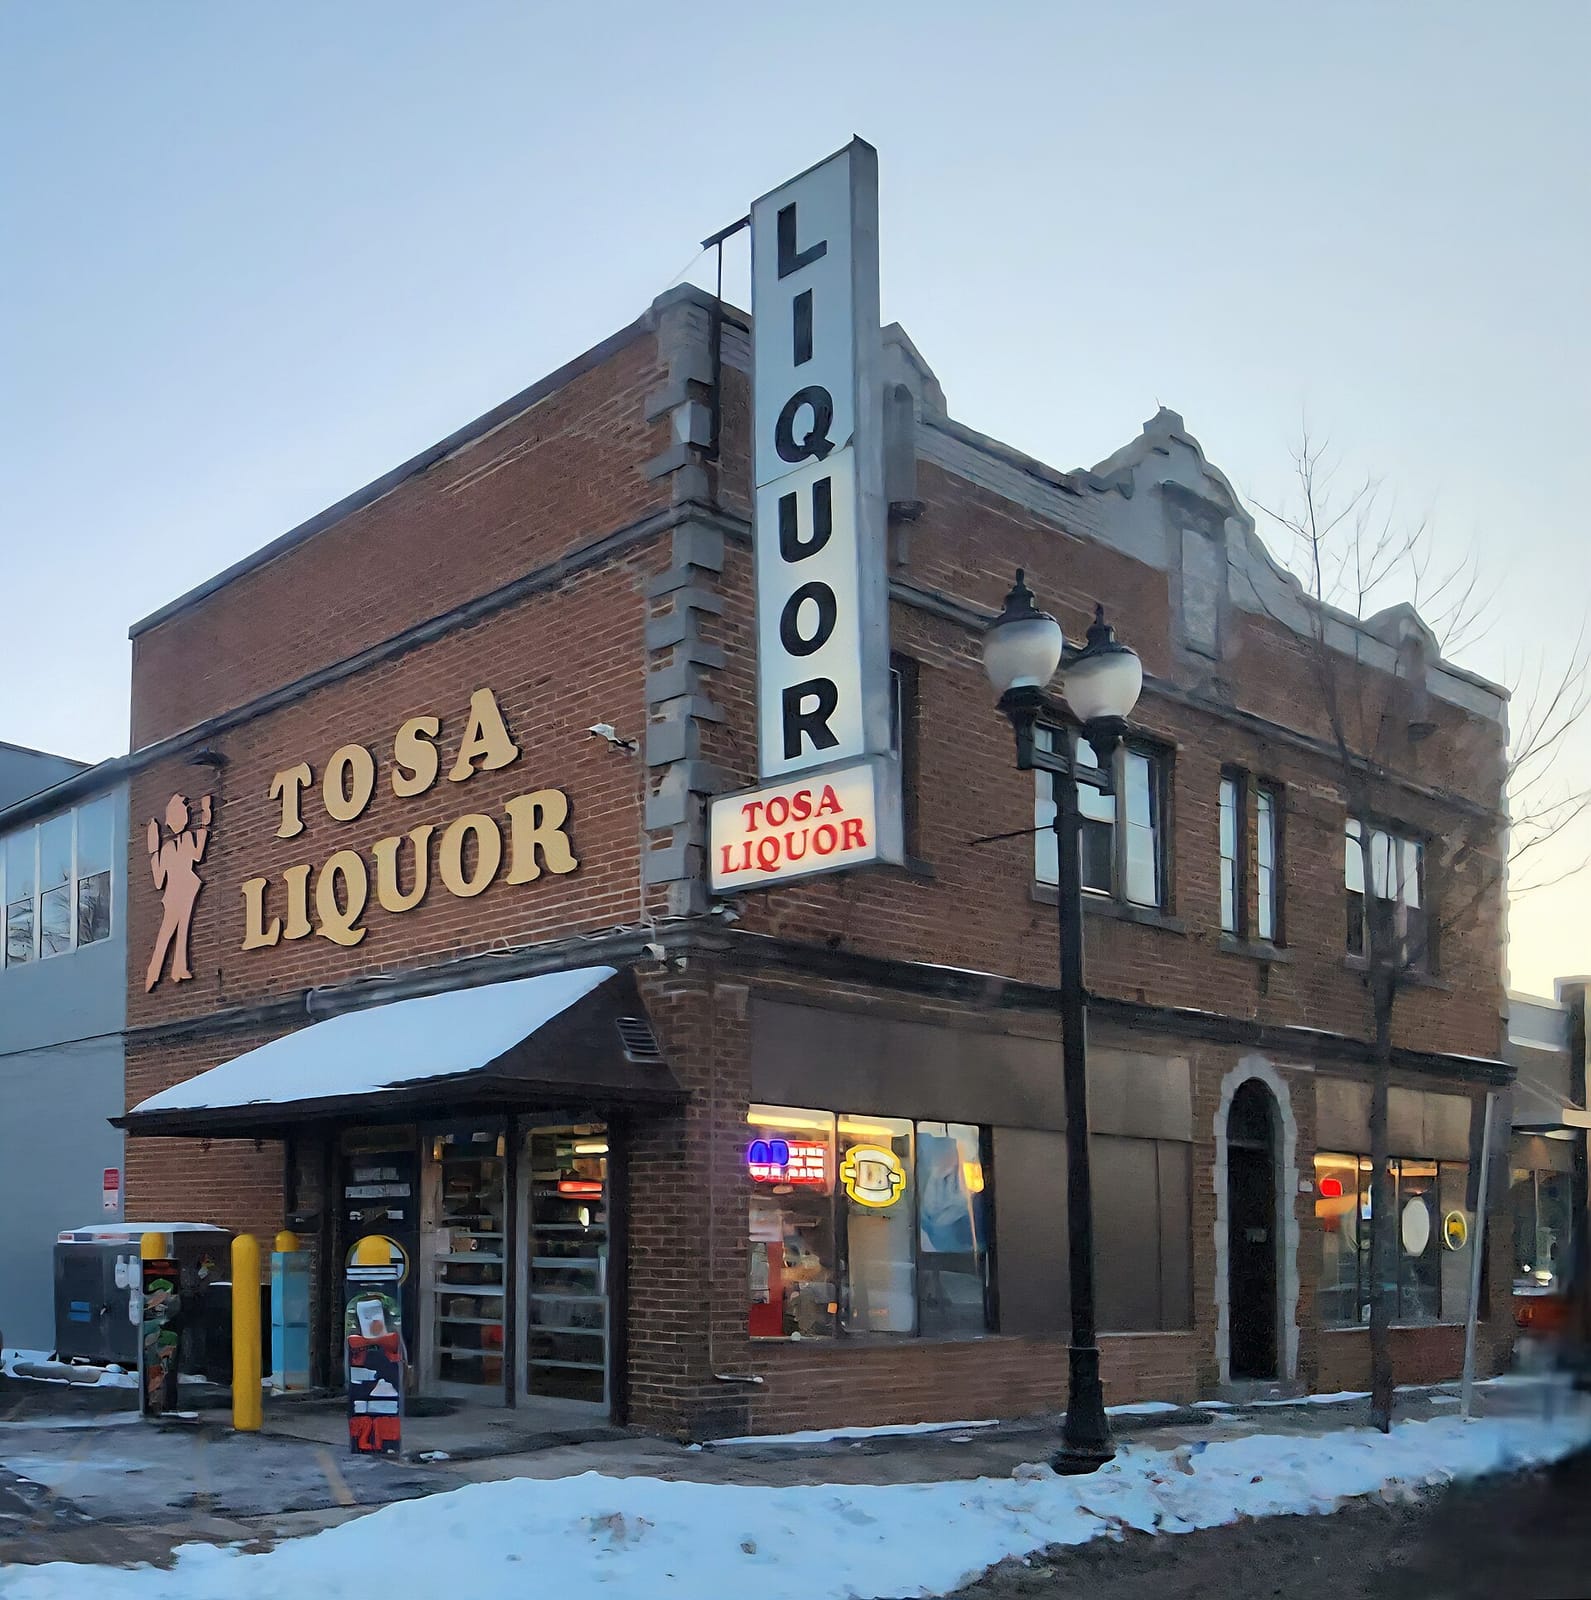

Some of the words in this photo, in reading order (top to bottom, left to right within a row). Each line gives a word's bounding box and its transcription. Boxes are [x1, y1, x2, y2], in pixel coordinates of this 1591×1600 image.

[775, 202, 840, 760] LIQUOR
[269, 688, 519, 838] TOSA
[742, 784, 844, 832] TOSA
[241, 788, 578, 950] LIQUOR
[720, 818, 867, 874] LIQUOR
